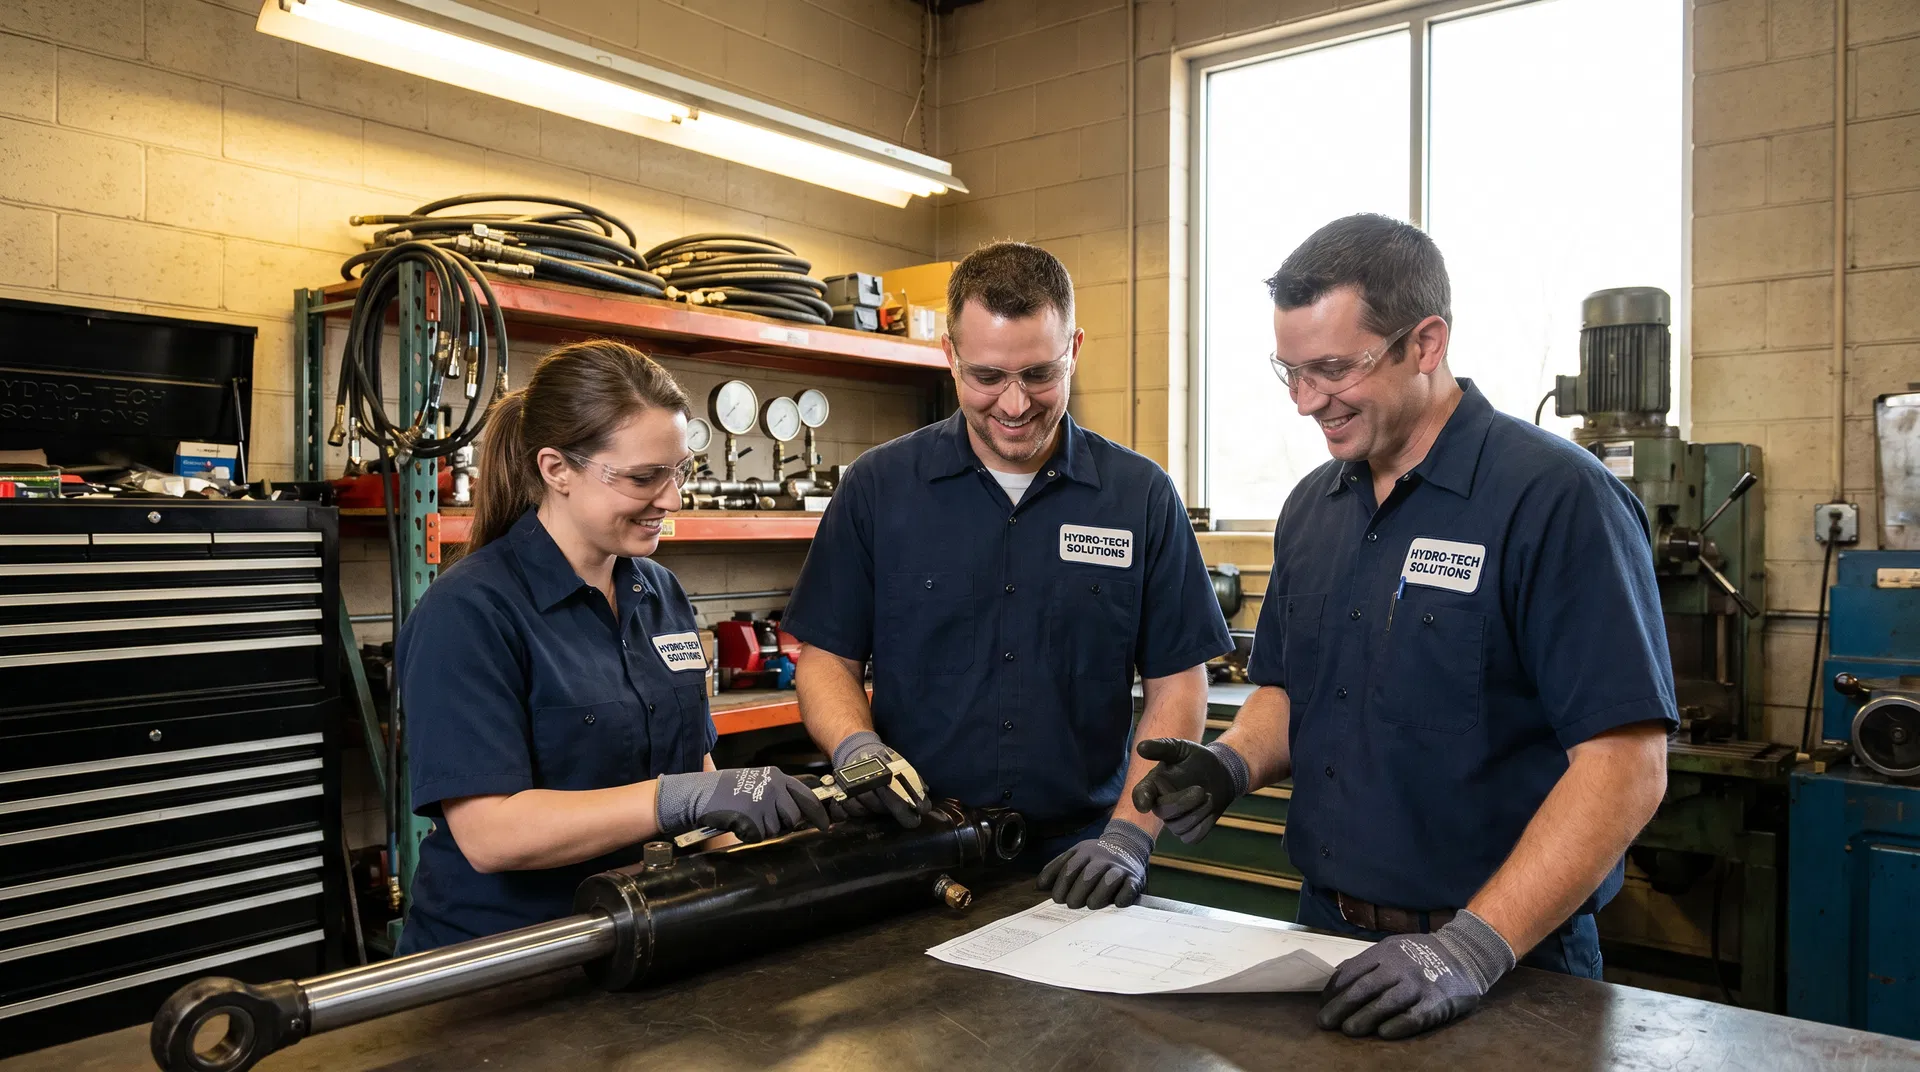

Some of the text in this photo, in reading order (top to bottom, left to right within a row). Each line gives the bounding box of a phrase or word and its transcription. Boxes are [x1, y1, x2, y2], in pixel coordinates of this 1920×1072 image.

[0, 379, 168, 406] YDRO-TECH
[1064, 533, 1129, 548] HYDRO-TECH
[1066, 544, 1125, 558] SOLUTIONS
[1410, 549, 1480, 568] HYDRO-TECH
[1409, 562, 1472, 580] SOLUTIONS
[658, 641, 699, 653] HYDRO-TECH
